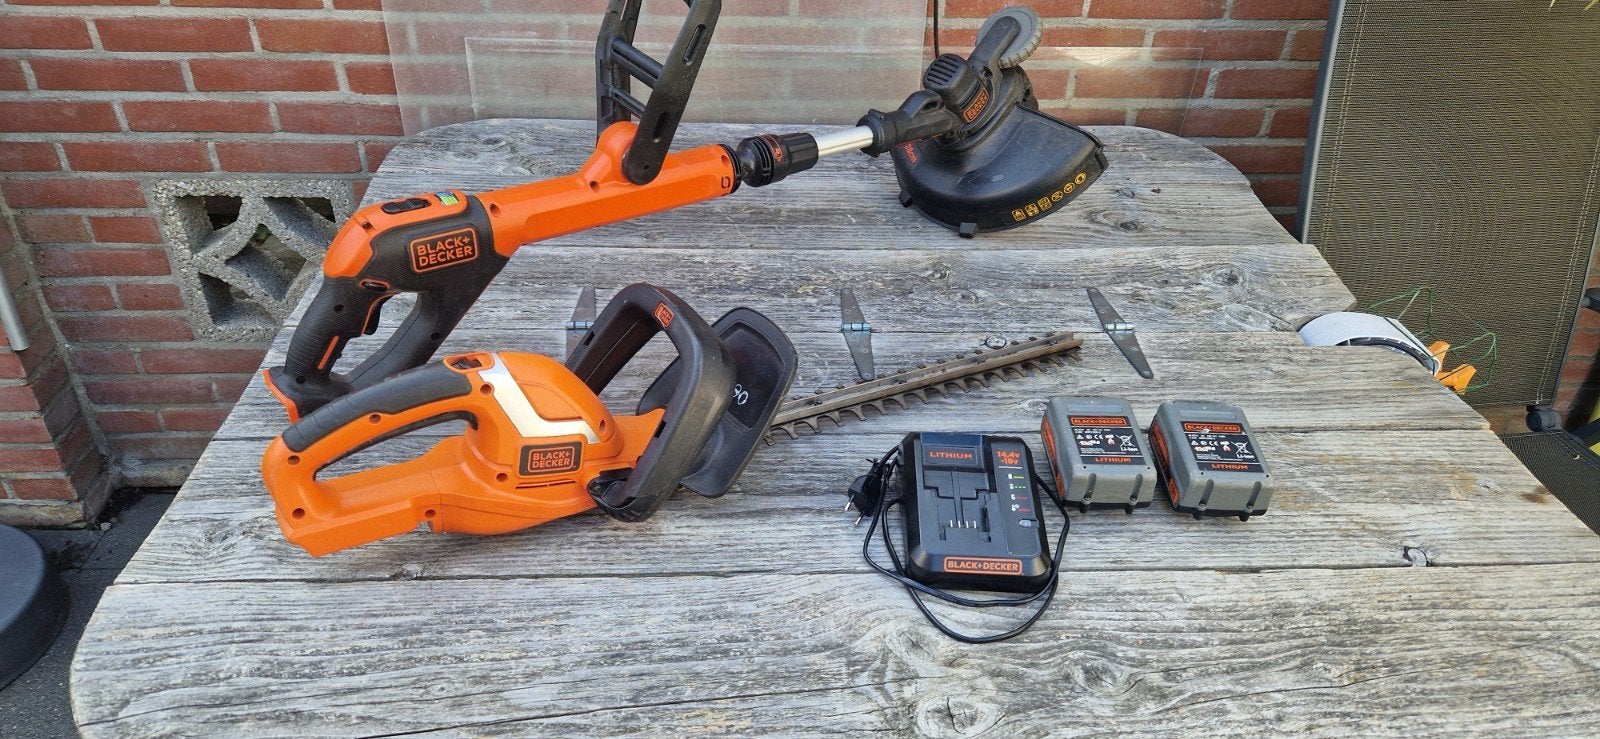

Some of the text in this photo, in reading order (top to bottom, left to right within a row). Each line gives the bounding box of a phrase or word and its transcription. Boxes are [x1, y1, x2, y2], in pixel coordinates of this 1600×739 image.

[417, 236, 471, 256] BLACK+
[419, 246, 473, 267] DECKER
[533, 450, 570, 461] BLACK+
[930, 451, 973, 459] LITHIUM
[532, 458, 571, 469] DECKER
[947, 560, 1019, 571] BLACK+DECKER
